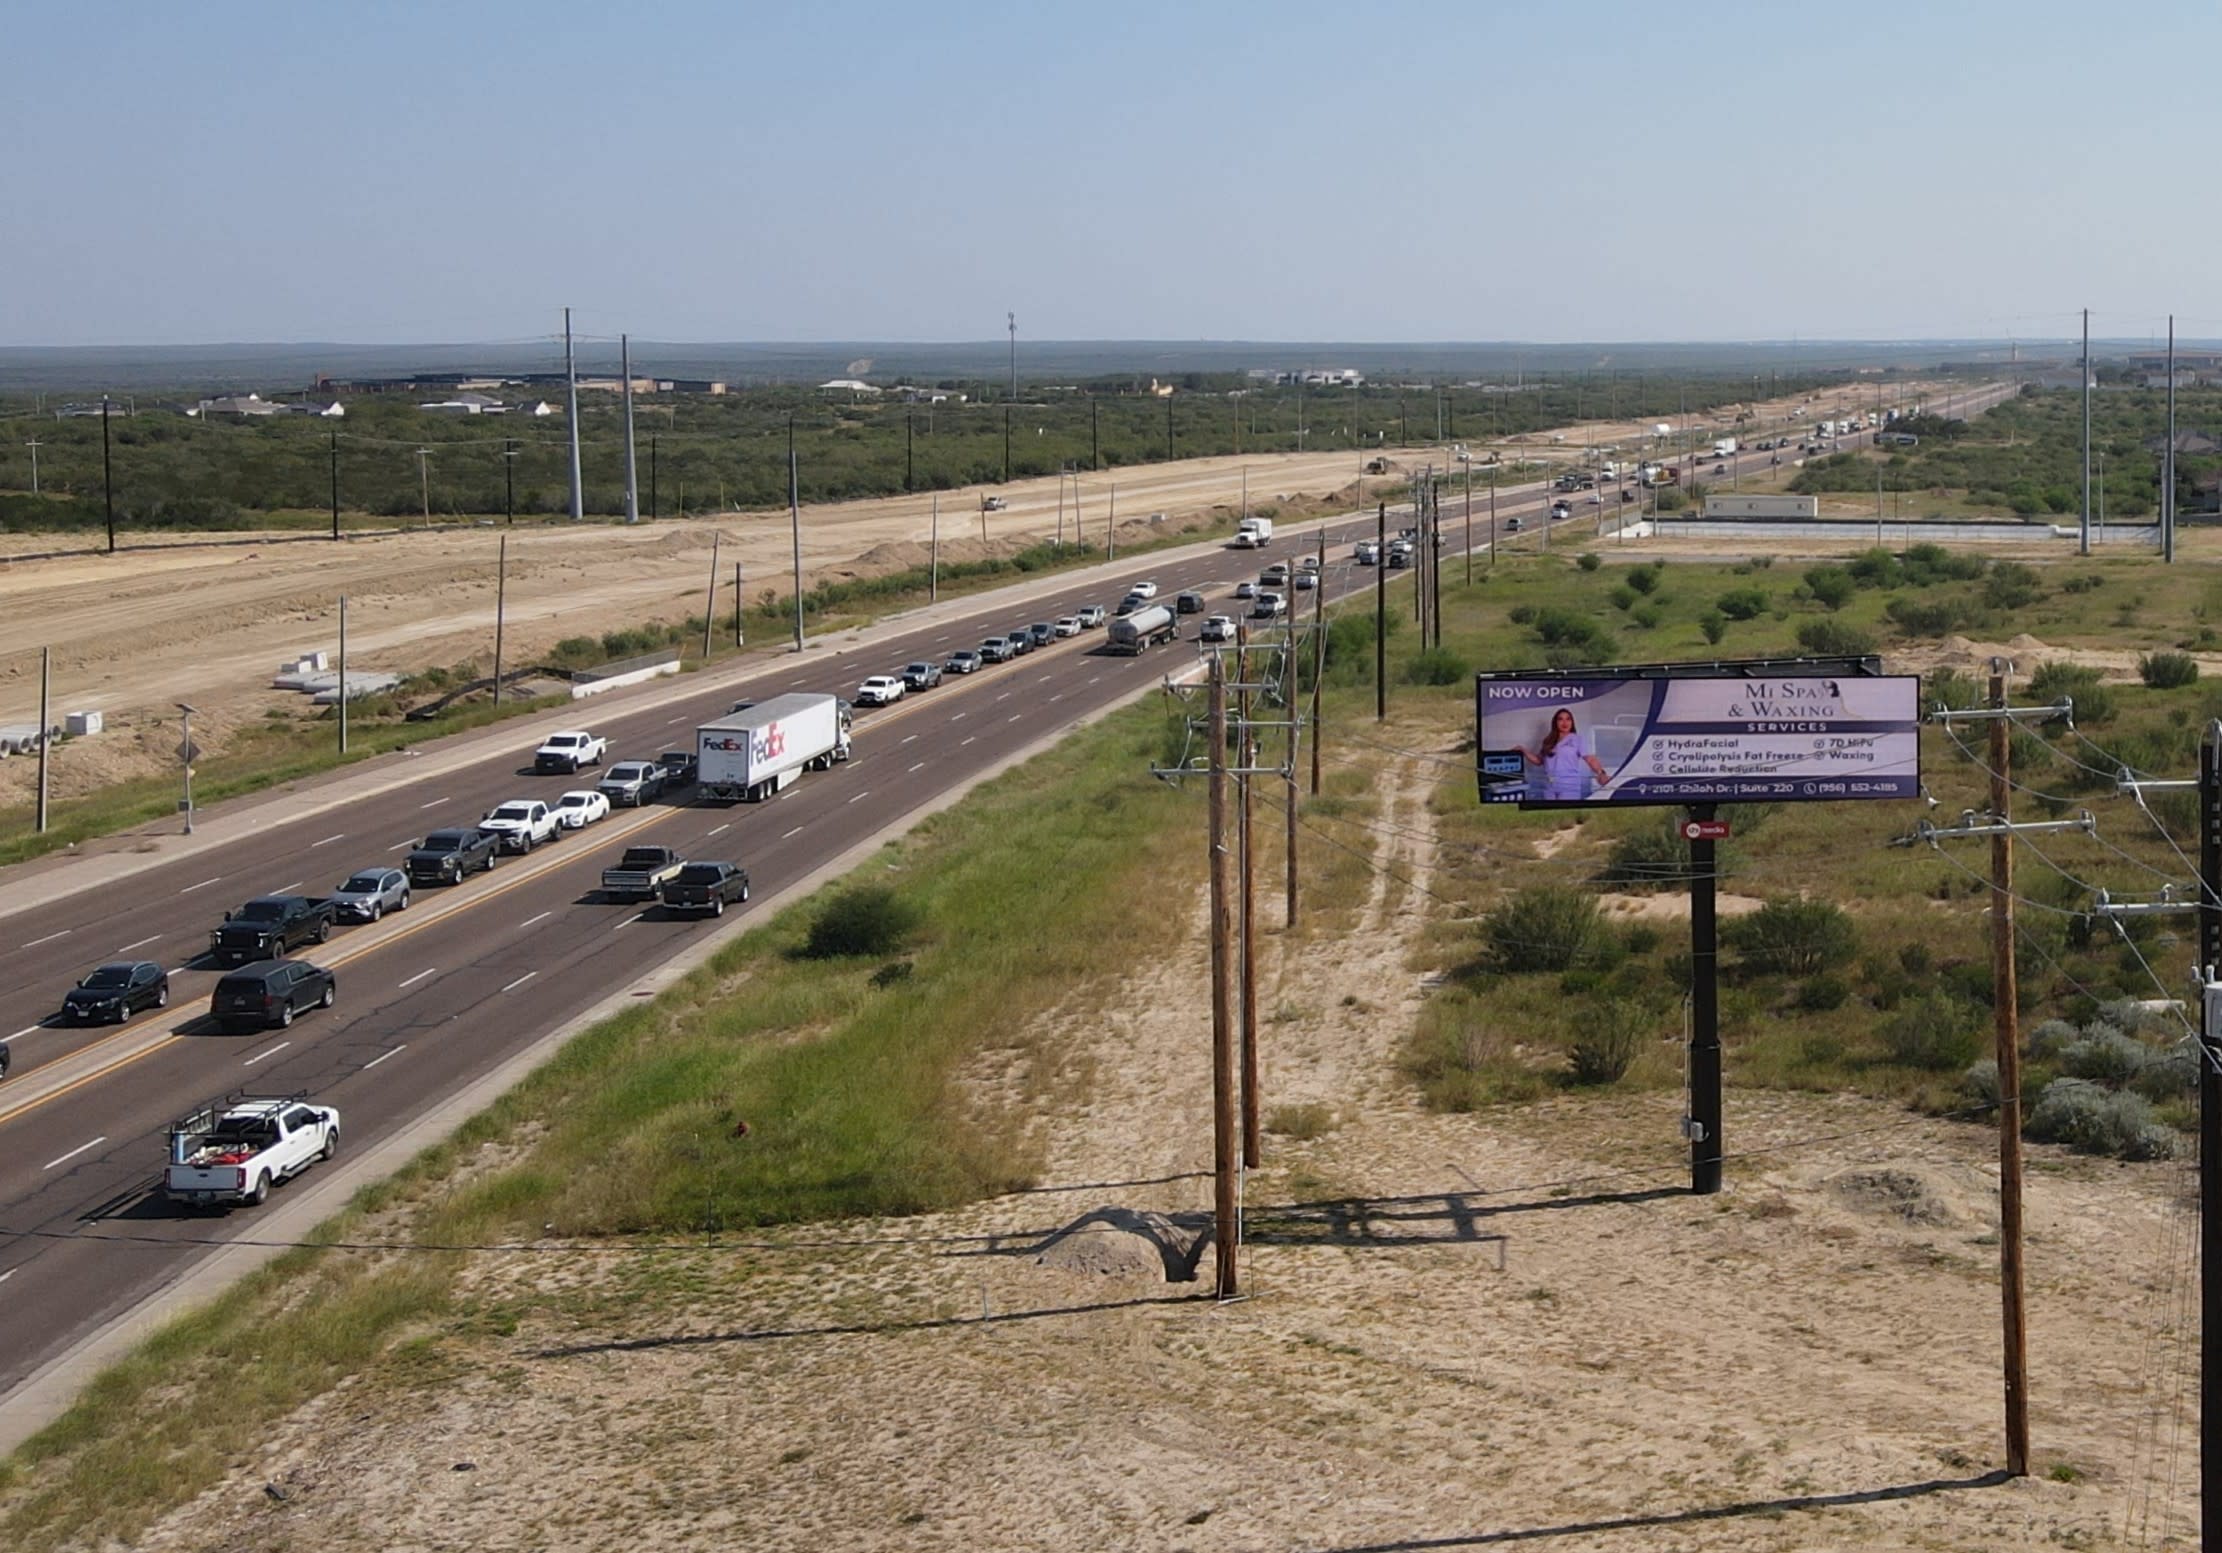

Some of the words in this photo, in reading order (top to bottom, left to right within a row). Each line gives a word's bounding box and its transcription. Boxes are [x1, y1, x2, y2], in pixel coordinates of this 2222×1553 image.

[1489, 687, 1532, 698] NOW
[1537, 686, 1584, 698] OPEN
[1728, 703, 1744, 718] &
[1747, 722, 1827, 732] SERVICES
[703, 737, 743, 751] FedEx
[750, 721, 785, 767] FedEx
[1668, 739, 1739, 750] HydraFacial
[1744, 751, 1762, 761] Fat
[1829, 751, 1874, 762] Waxing
[1740, 783, 1769, 793] Suite
[1773, 783, 1794, 793] 220
